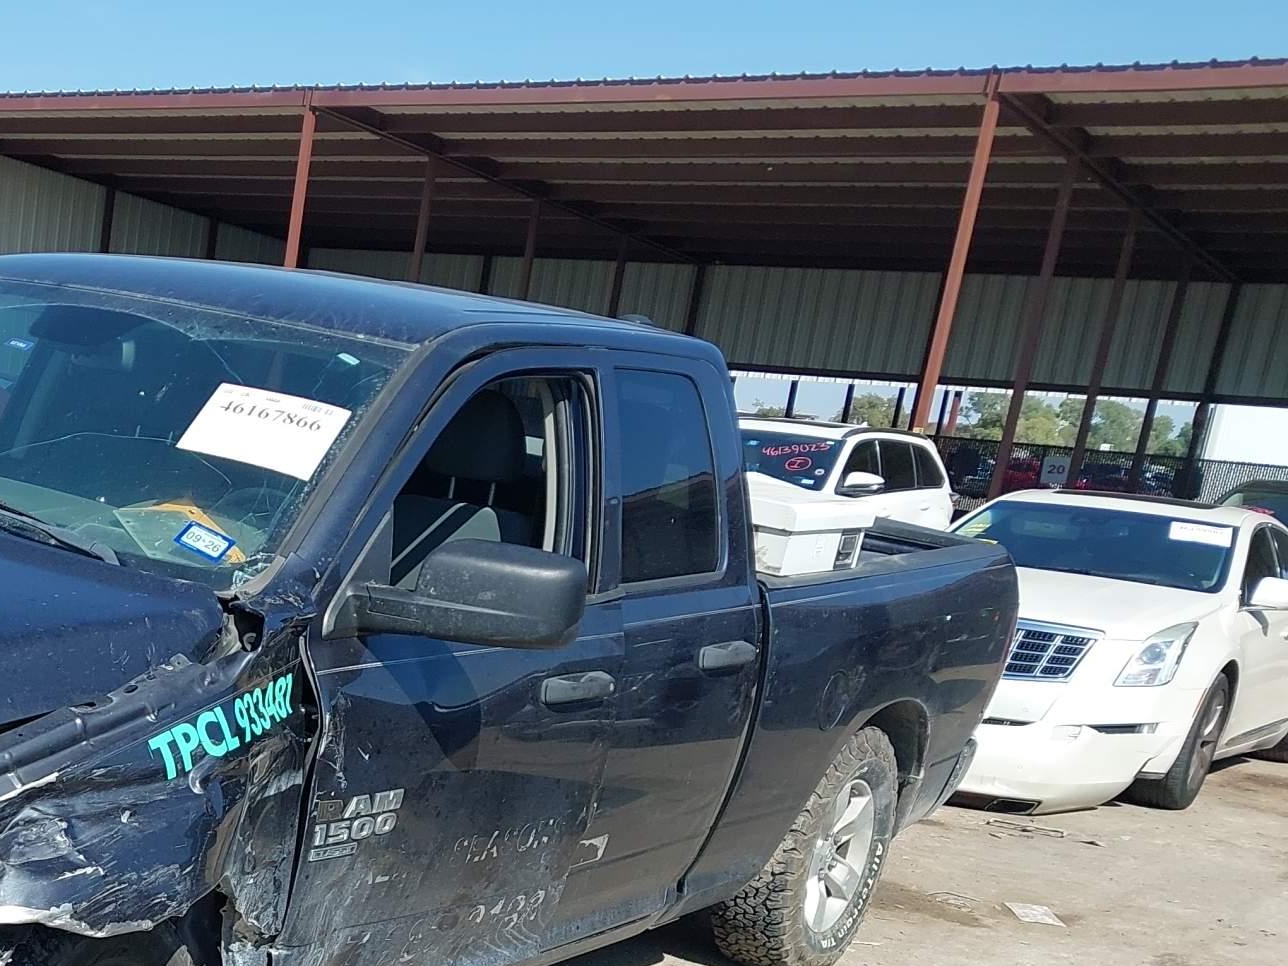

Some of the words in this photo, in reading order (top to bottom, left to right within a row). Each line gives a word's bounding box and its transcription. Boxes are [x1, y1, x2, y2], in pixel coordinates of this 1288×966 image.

[220, 400, 322, 432] 46167866
[1047, 464, 1066, 475] 20
[147, 706, 241, 780] TPCL
[315, 788, 405, 821] RAM
[313, 812, 397, 846] 1500
